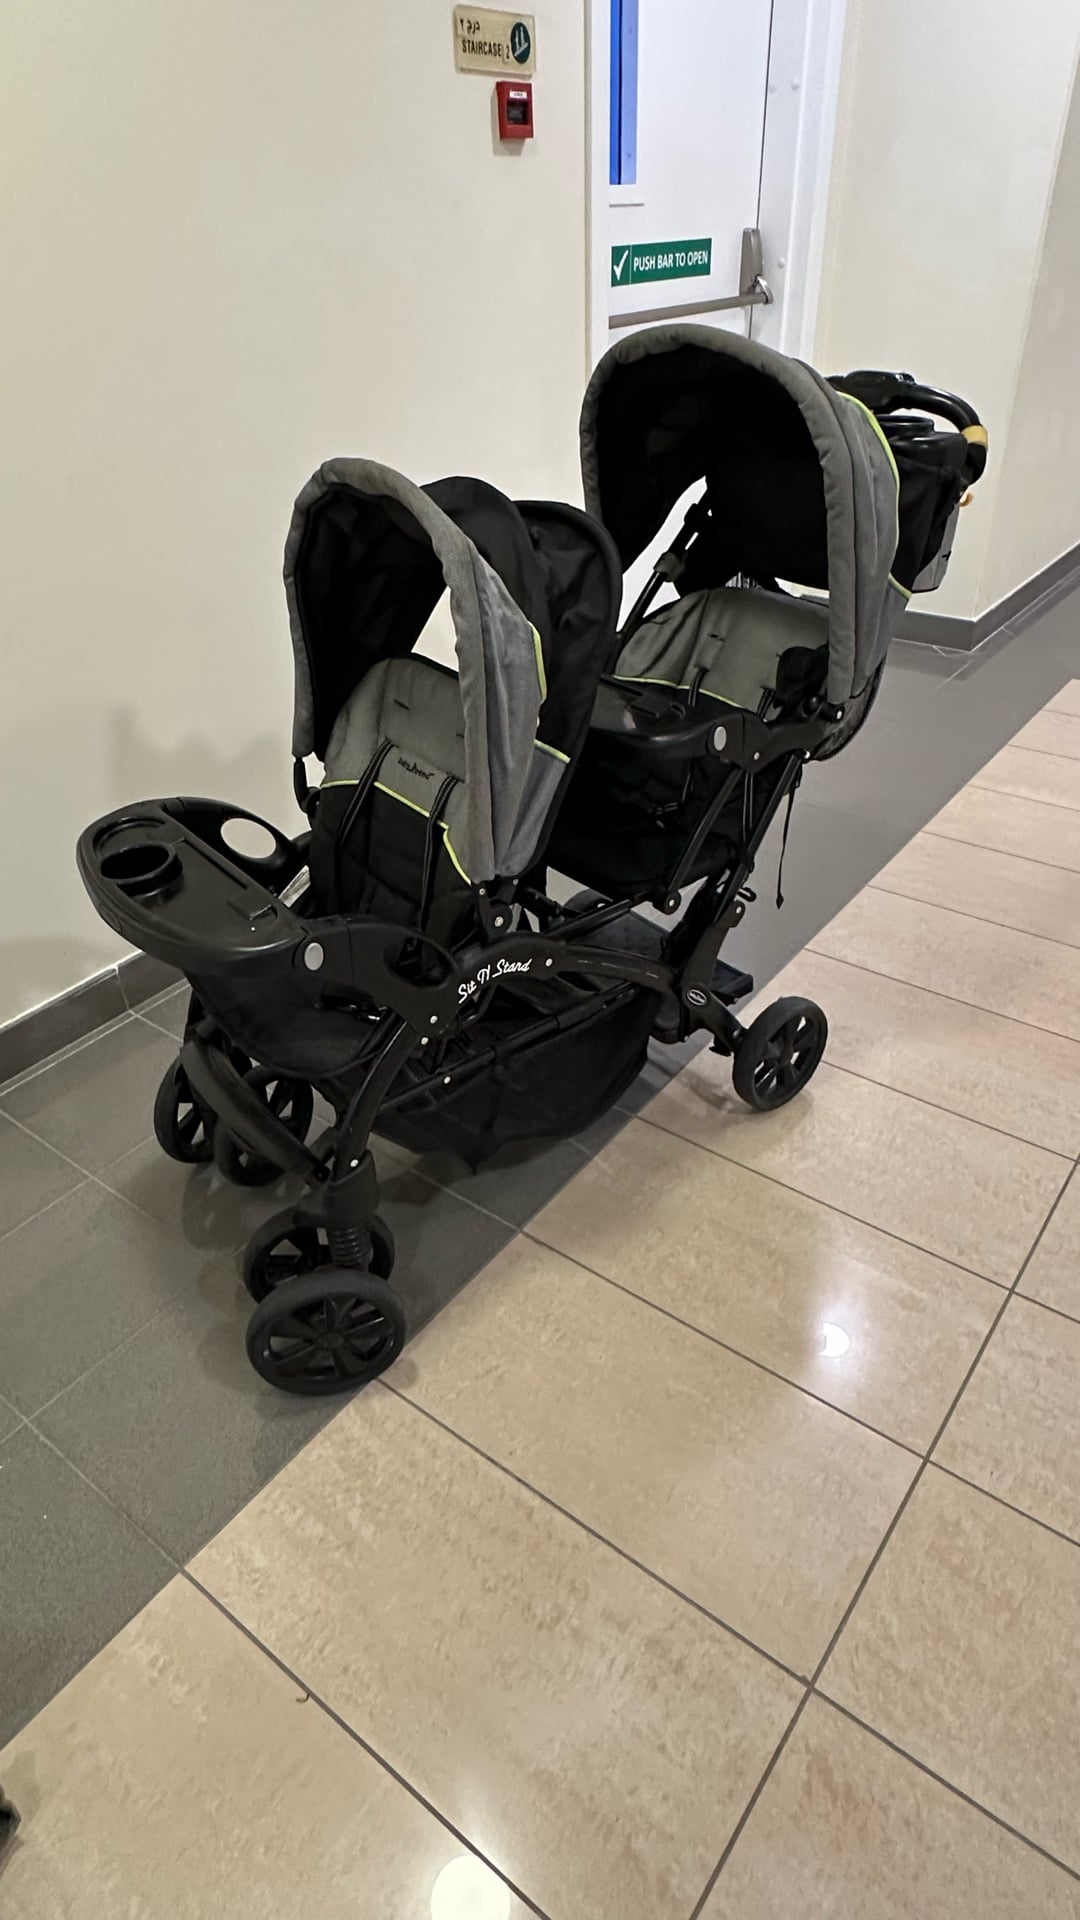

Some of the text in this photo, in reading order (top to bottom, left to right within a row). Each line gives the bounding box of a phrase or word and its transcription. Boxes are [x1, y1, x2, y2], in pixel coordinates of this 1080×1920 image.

[461, 39, 510, 59] STAIRCASE 2
[633, 250, 708, 272] PUSH BAR TO OPEN
[458, 980, 477, 1004] Sit
[491, 958, 533, 978] Stand
